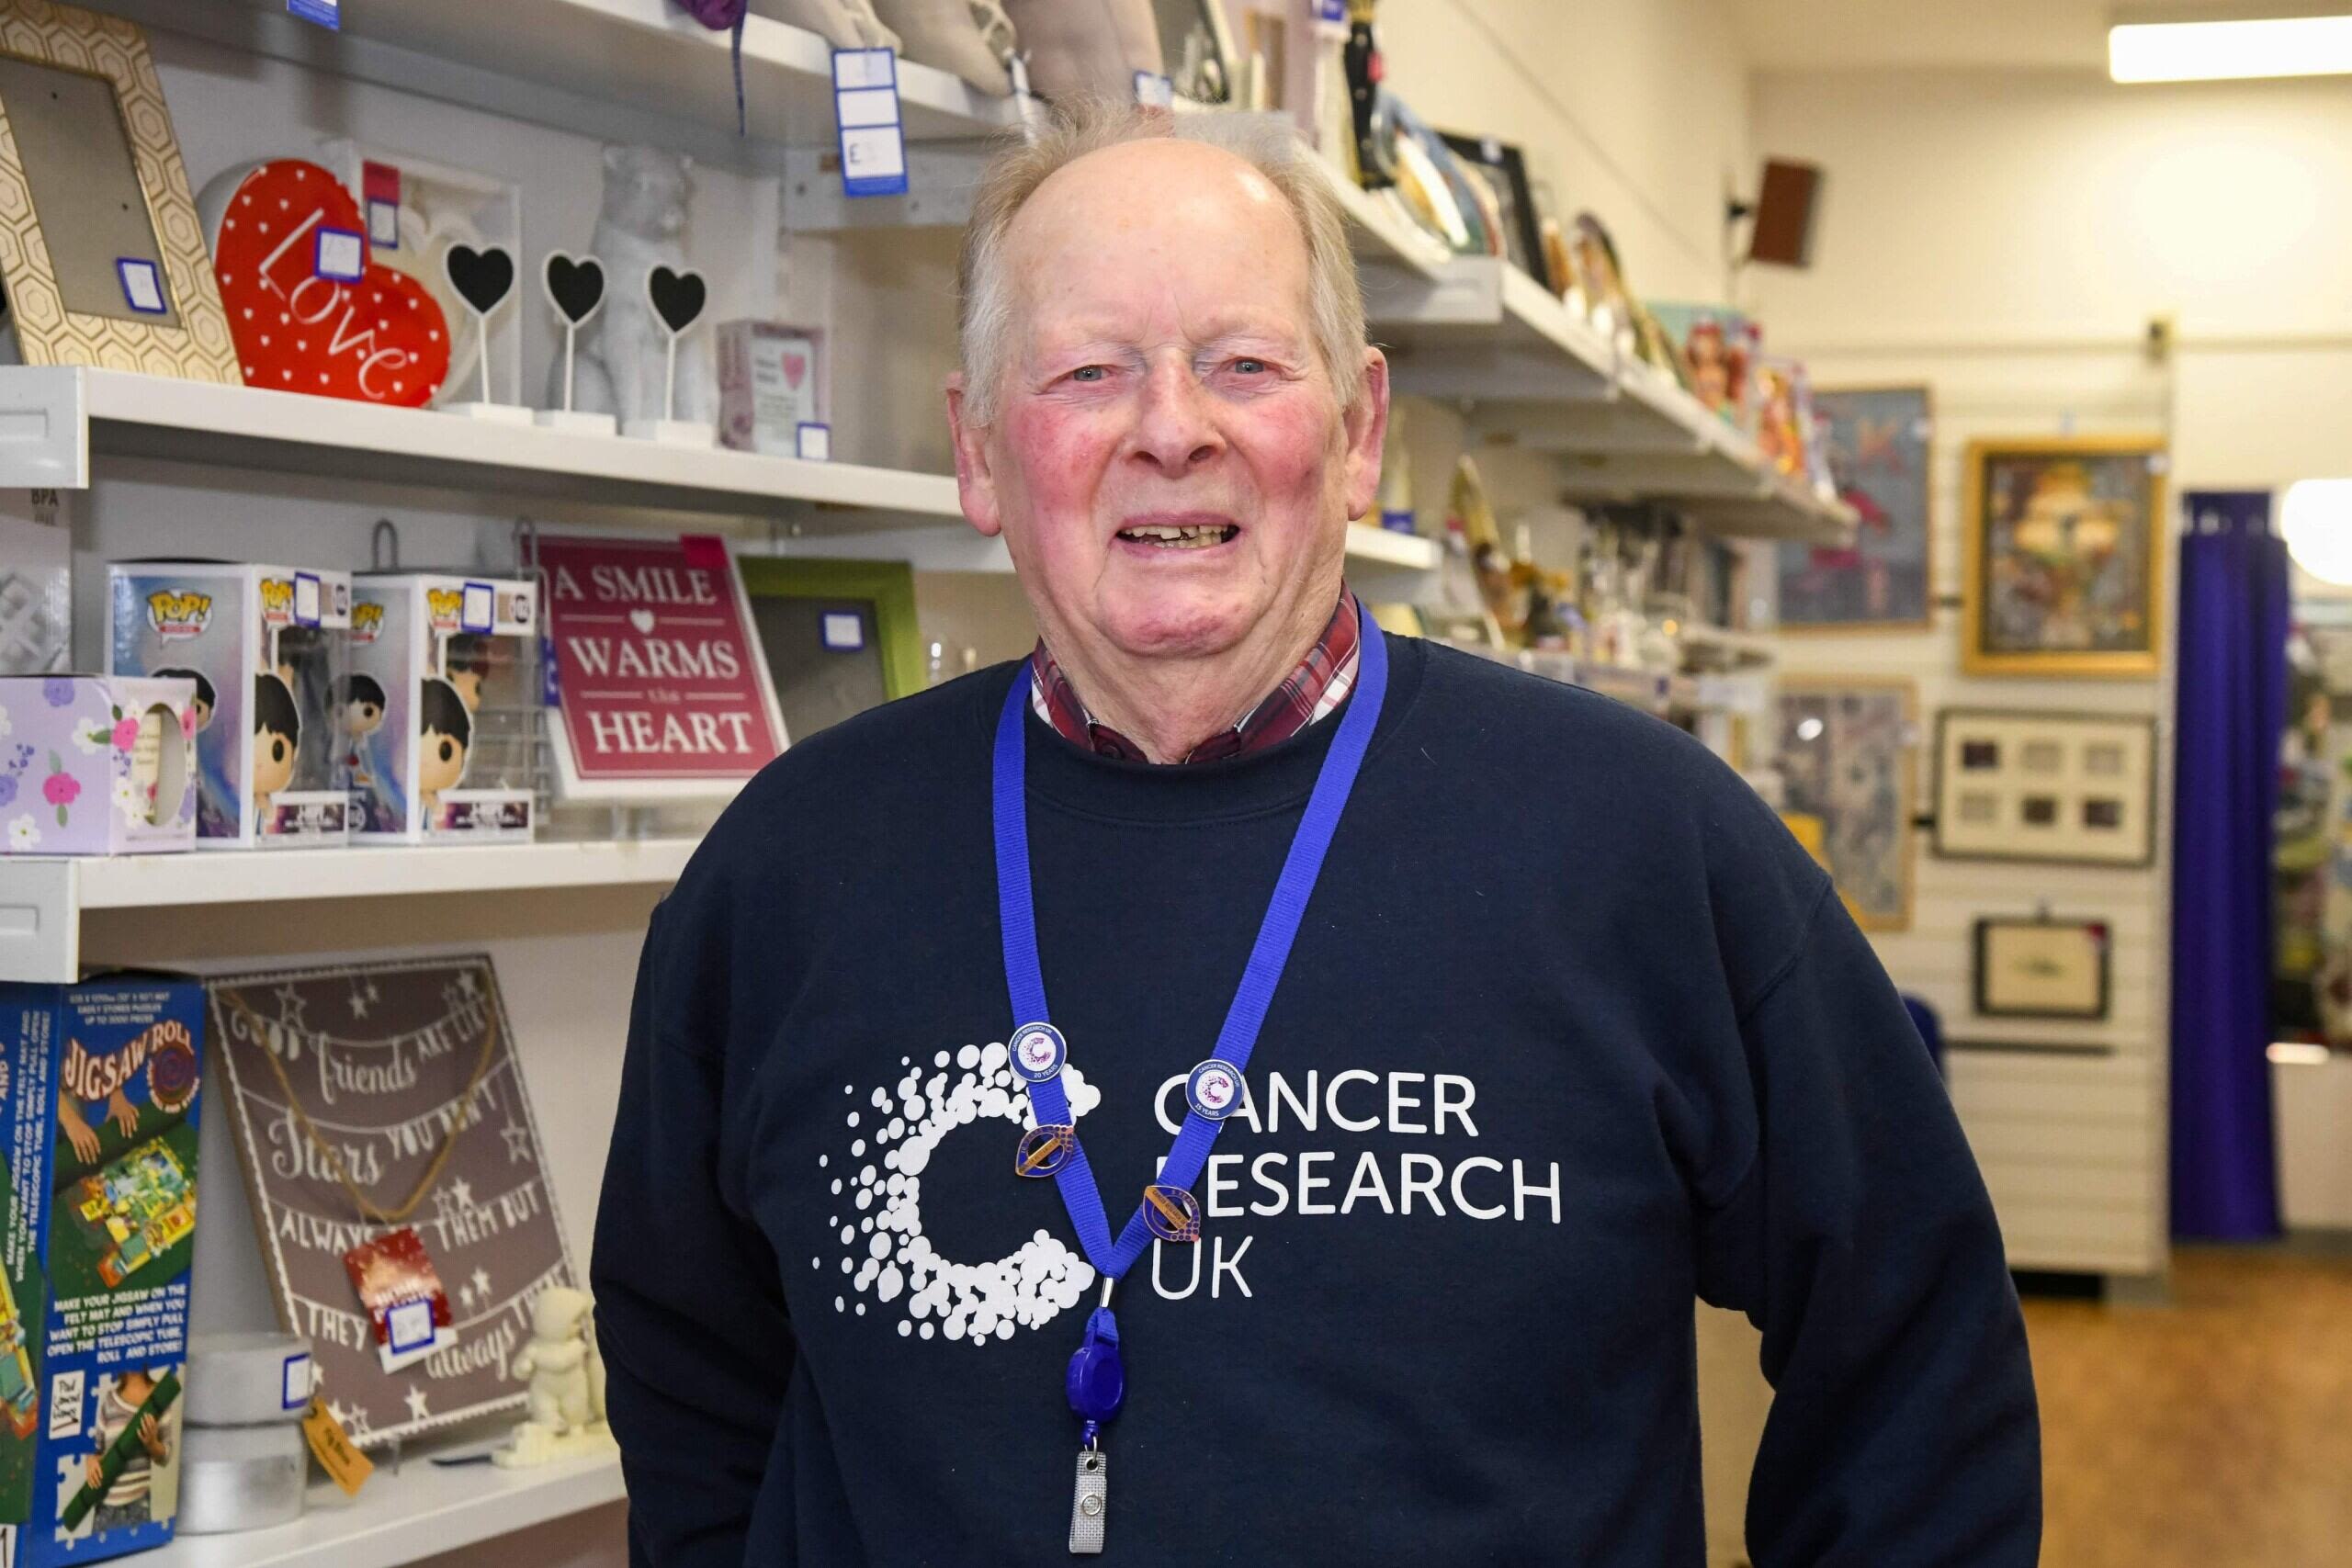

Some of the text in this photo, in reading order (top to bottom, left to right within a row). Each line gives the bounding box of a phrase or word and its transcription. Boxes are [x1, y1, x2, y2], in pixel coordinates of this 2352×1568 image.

[258, 207, 408, 399] Love
[554, 565, 718, 605] A SMILE
[148, 590, 212, 624] POP!
[567, 637, 741, 679] WARMS
[587, 711, 752, 754] HEART
[64, 1031, 148, 1100] JIGSAW
[152, 1020, 195, 1055] ROLL
[308, 1030, 416, 1105] friends
[1041, 1064, 1058, 1077] YEARS
[1202, 1108, 1220, 1117] YEARS
[385, 1121, 435, 1161] YOU
[1156, 1151, 1560, 1224] ESEARCH
[434, 1208, 499, 1251] THEM
[500, 1183, 540, 1228] BUT
[1152, 1235, 1253, 1300] UK
[54, 1297, 80, 1312] MAKE
[83, 1293, 110, 1307] YOUR
[167, 1283, 187, 1295] THE
[64, 1312, 87, 1325] FELT
[111, 1304, 133, 1318] AND
[50, 1326, 80, 1342] WANT
[81, 1324, 96, 1337] TO
[96, 1320, 124, 1335] STOP
[298, 1301, 368, 1351] THEY
[125, 1346, 147, 1359] AND
